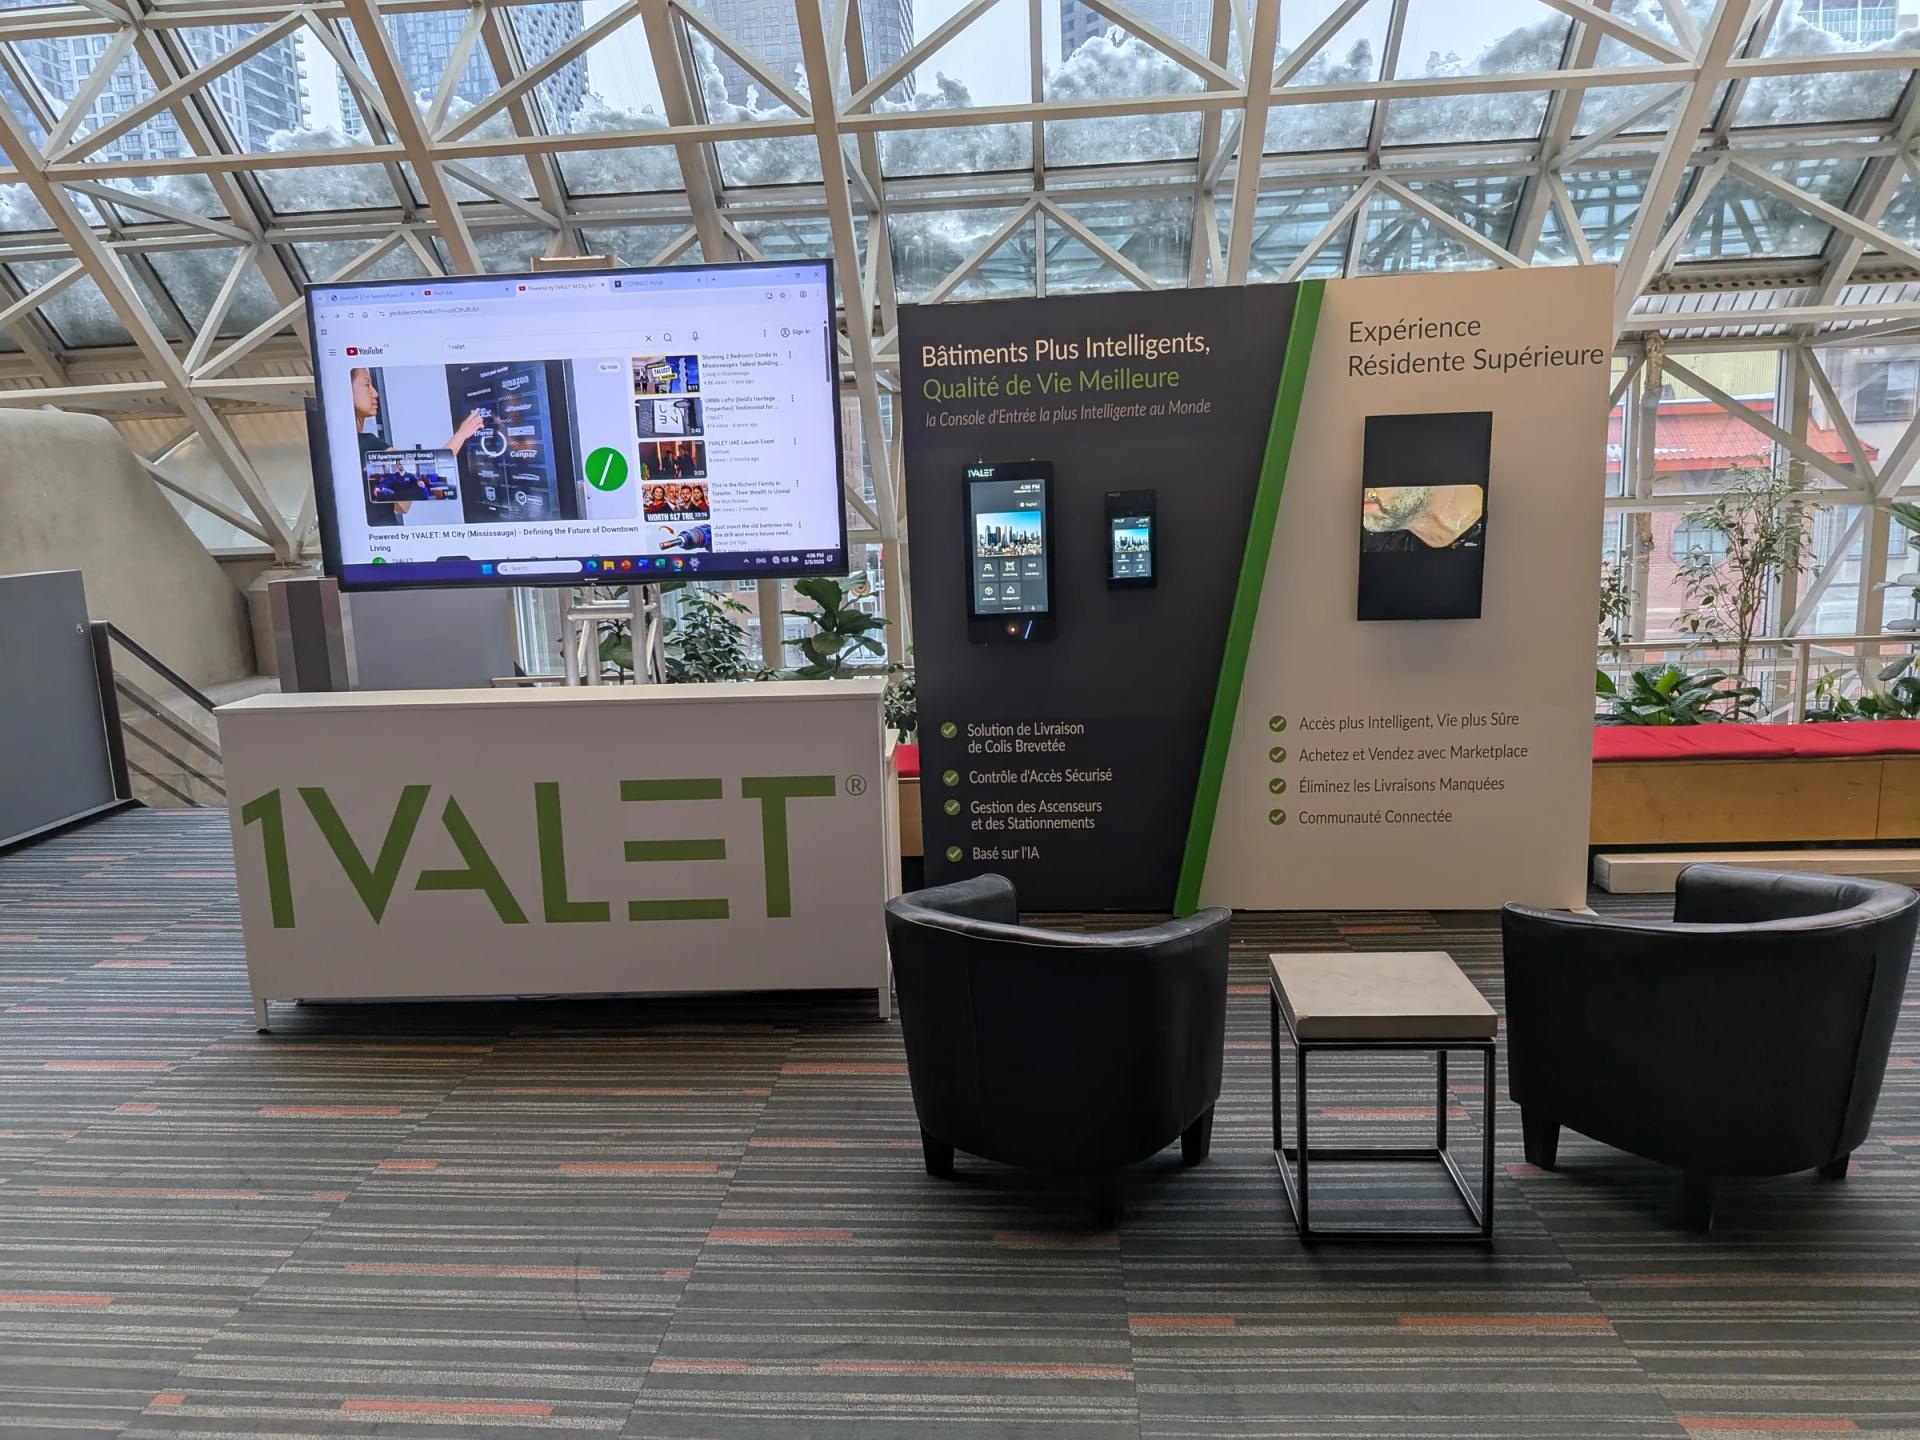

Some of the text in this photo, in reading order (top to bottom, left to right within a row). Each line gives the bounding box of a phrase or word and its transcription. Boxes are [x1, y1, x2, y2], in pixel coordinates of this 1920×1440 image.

[1350, 318, 1481, 346] Expérience
[358, 347, 383, 355] YouTube
[922, 332, 1210, 367] Bâtiments Plus Intelligents,
[1349, 346, 1604, 377] Résidente Supérieure
[502, 375, 529, 389] amazon
[923, 368, 1180, 403] Qualité de Vie Meilleure
[926, 398, 1211, 428] la Console d'Entrée la plus Intelligente au Monde
[510, 450, 537, 459] Canpar
[968, 469, 995, 478] 1VALET
[647, 513, 669, 521] WORTH
[369, 532, 399, 541] Powered
[401, 531, 409, 541] by
[451, 529, 465, 539] City
[467, 528, 517, 539] (Mississauga)
[523, 527, 553, 537] Defining
[568, 526, 591, 535] Future
[592, 525, 600, 533] of
[601, 525, 638, 534] Downtown
[370, 544, 391, 552] Living
[967, 722, 1084, 737] Solution de Livraison
[1299, 712, 1519, 732] Accès plus Intelligent, Vie plus Sûre
[968, 739, 1066, 753] de Colis Brevetée
[1299, 744, 1528, 762] Achetez et Vendez avec Marketplace
[969, 768, 1112, 784] Contrôle d'Accès Sécurisé
[1299, 777, 1505, 793] Éliminez les Livraisons Manquées
[970, 800, 1102, 814] Gestion des Ascenseurs
[971, 816, 1095, 830] et des Stationnements
[1299, 809, 1453, 824] Communauté Connectée
[972, 846, 1040, 860] Basé sur l'IA
